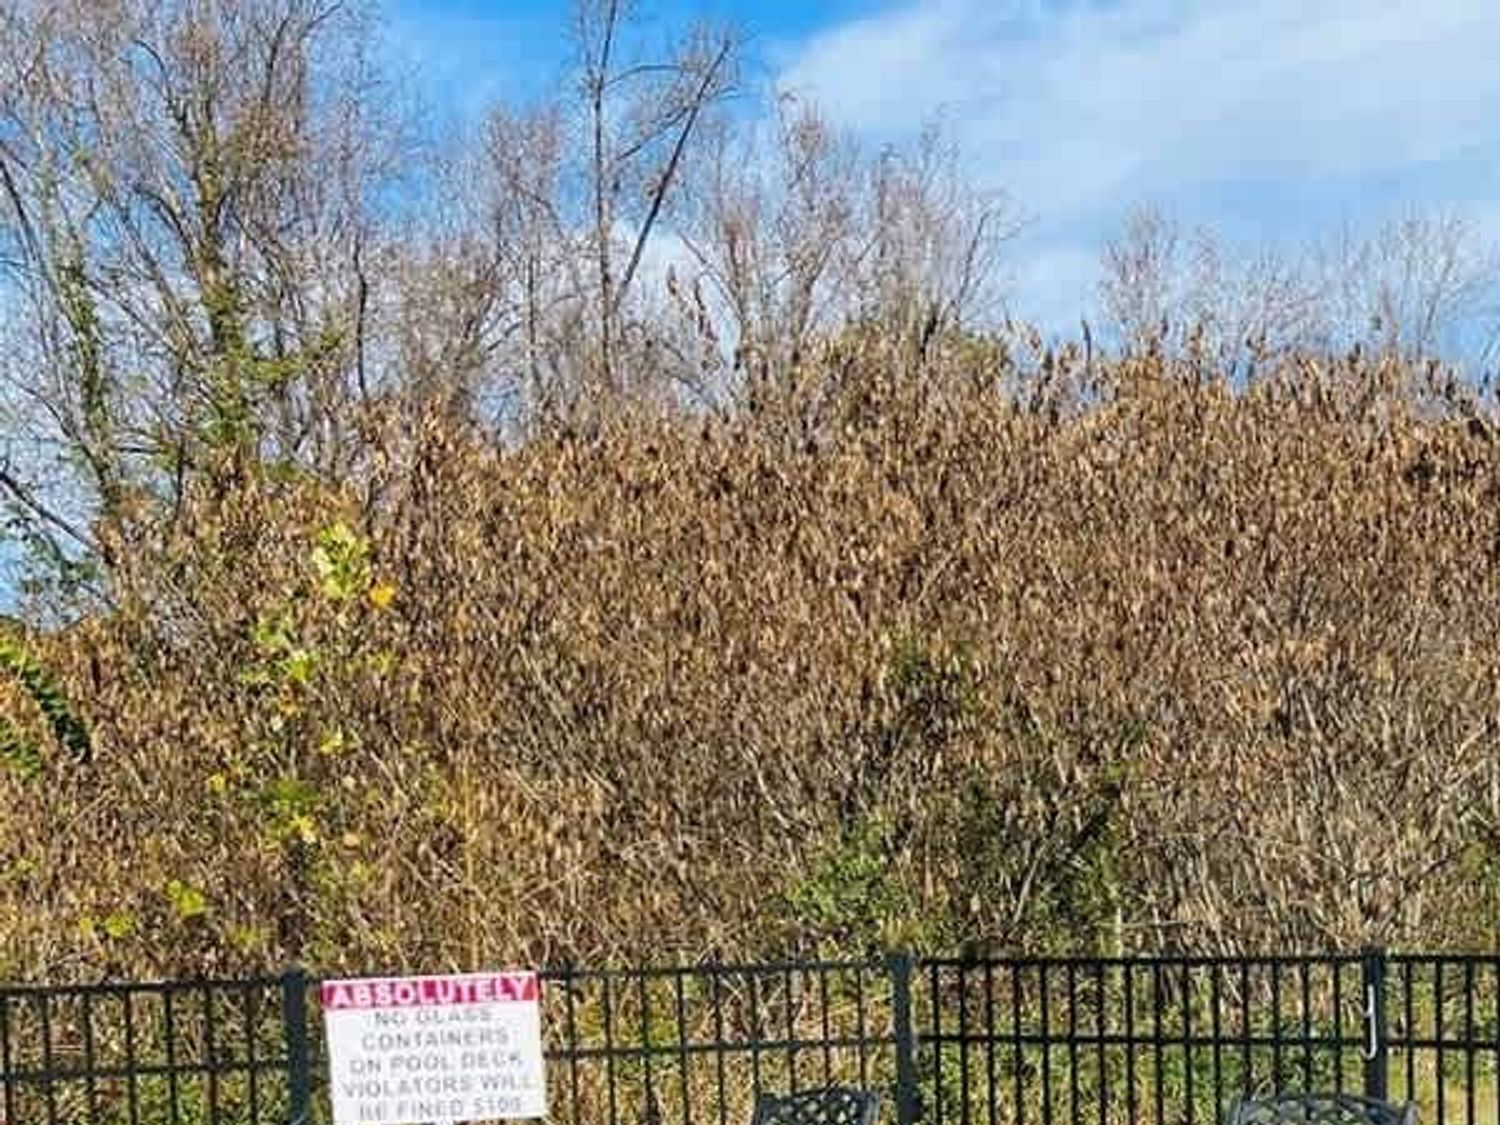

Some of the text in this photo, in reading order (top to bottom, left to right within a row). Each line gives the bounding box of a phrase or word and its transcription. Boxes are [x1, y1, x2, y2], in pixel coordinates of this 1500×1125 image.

[331, 976, 525, 1007] ABSOLUTELY
[373, 1010, 407, 1026] NO
[362, 1027, 509, 1052] CONTAINERS
[350, 1051, 524, 1075] ON POOL DECK
[342, 1074, 534, 1100] VIOLATORS WILL
[394, 1098, 466, 1121] FINED
